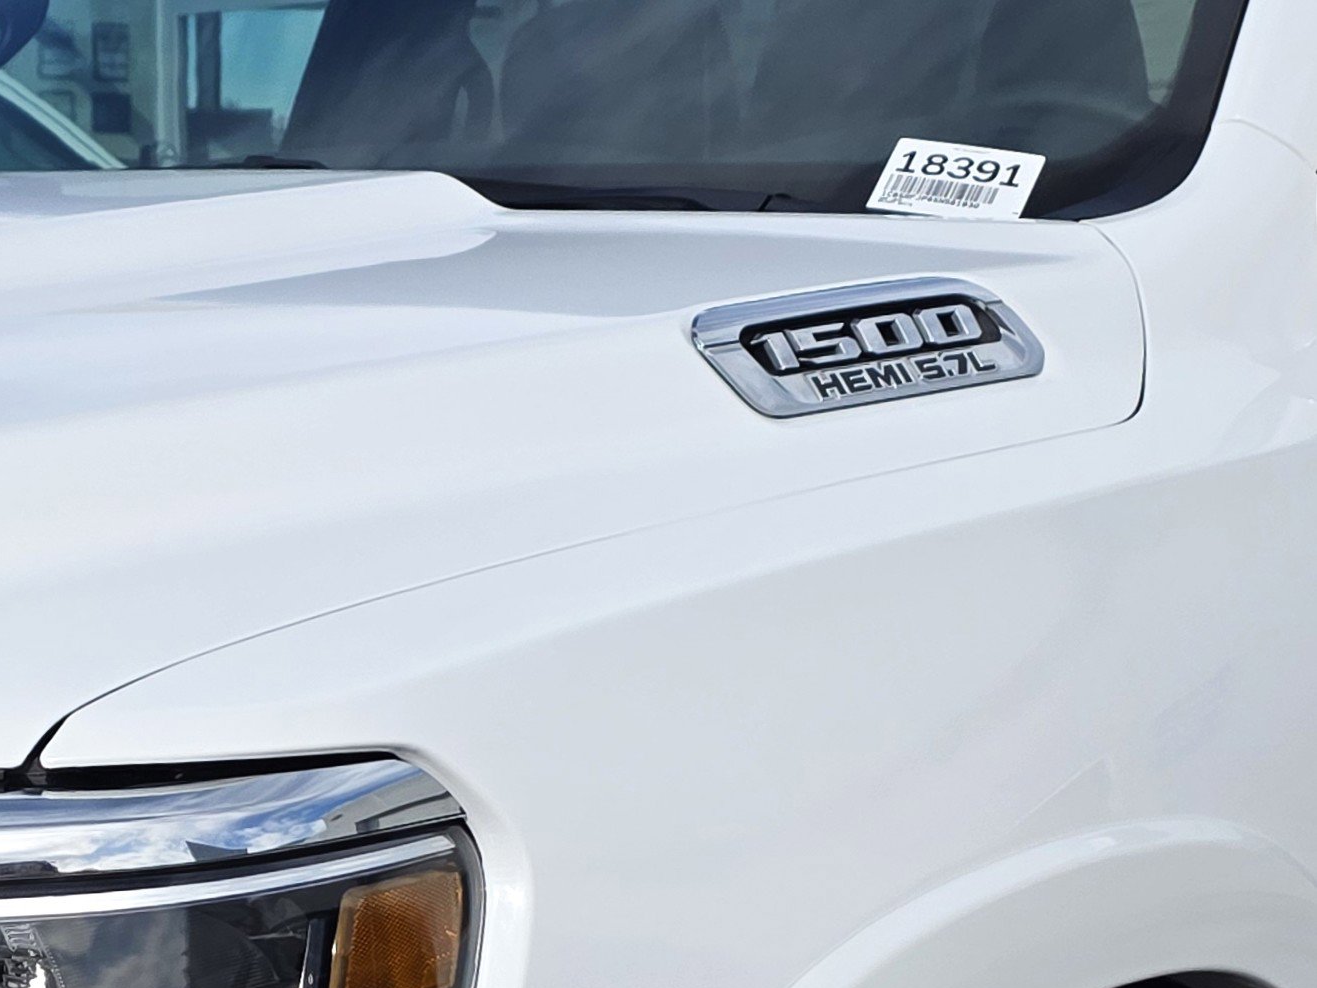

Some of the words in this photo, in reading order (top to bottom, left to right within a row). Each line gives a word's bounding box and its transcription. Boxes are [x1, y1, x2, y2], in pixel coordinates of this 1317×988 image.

[895, 151, 1021, 188] 18391
[750, 303, 982, 371] 1500
[810, 362, 911, 401] HEMI
[915, 350, 997, 382] 5.7L
